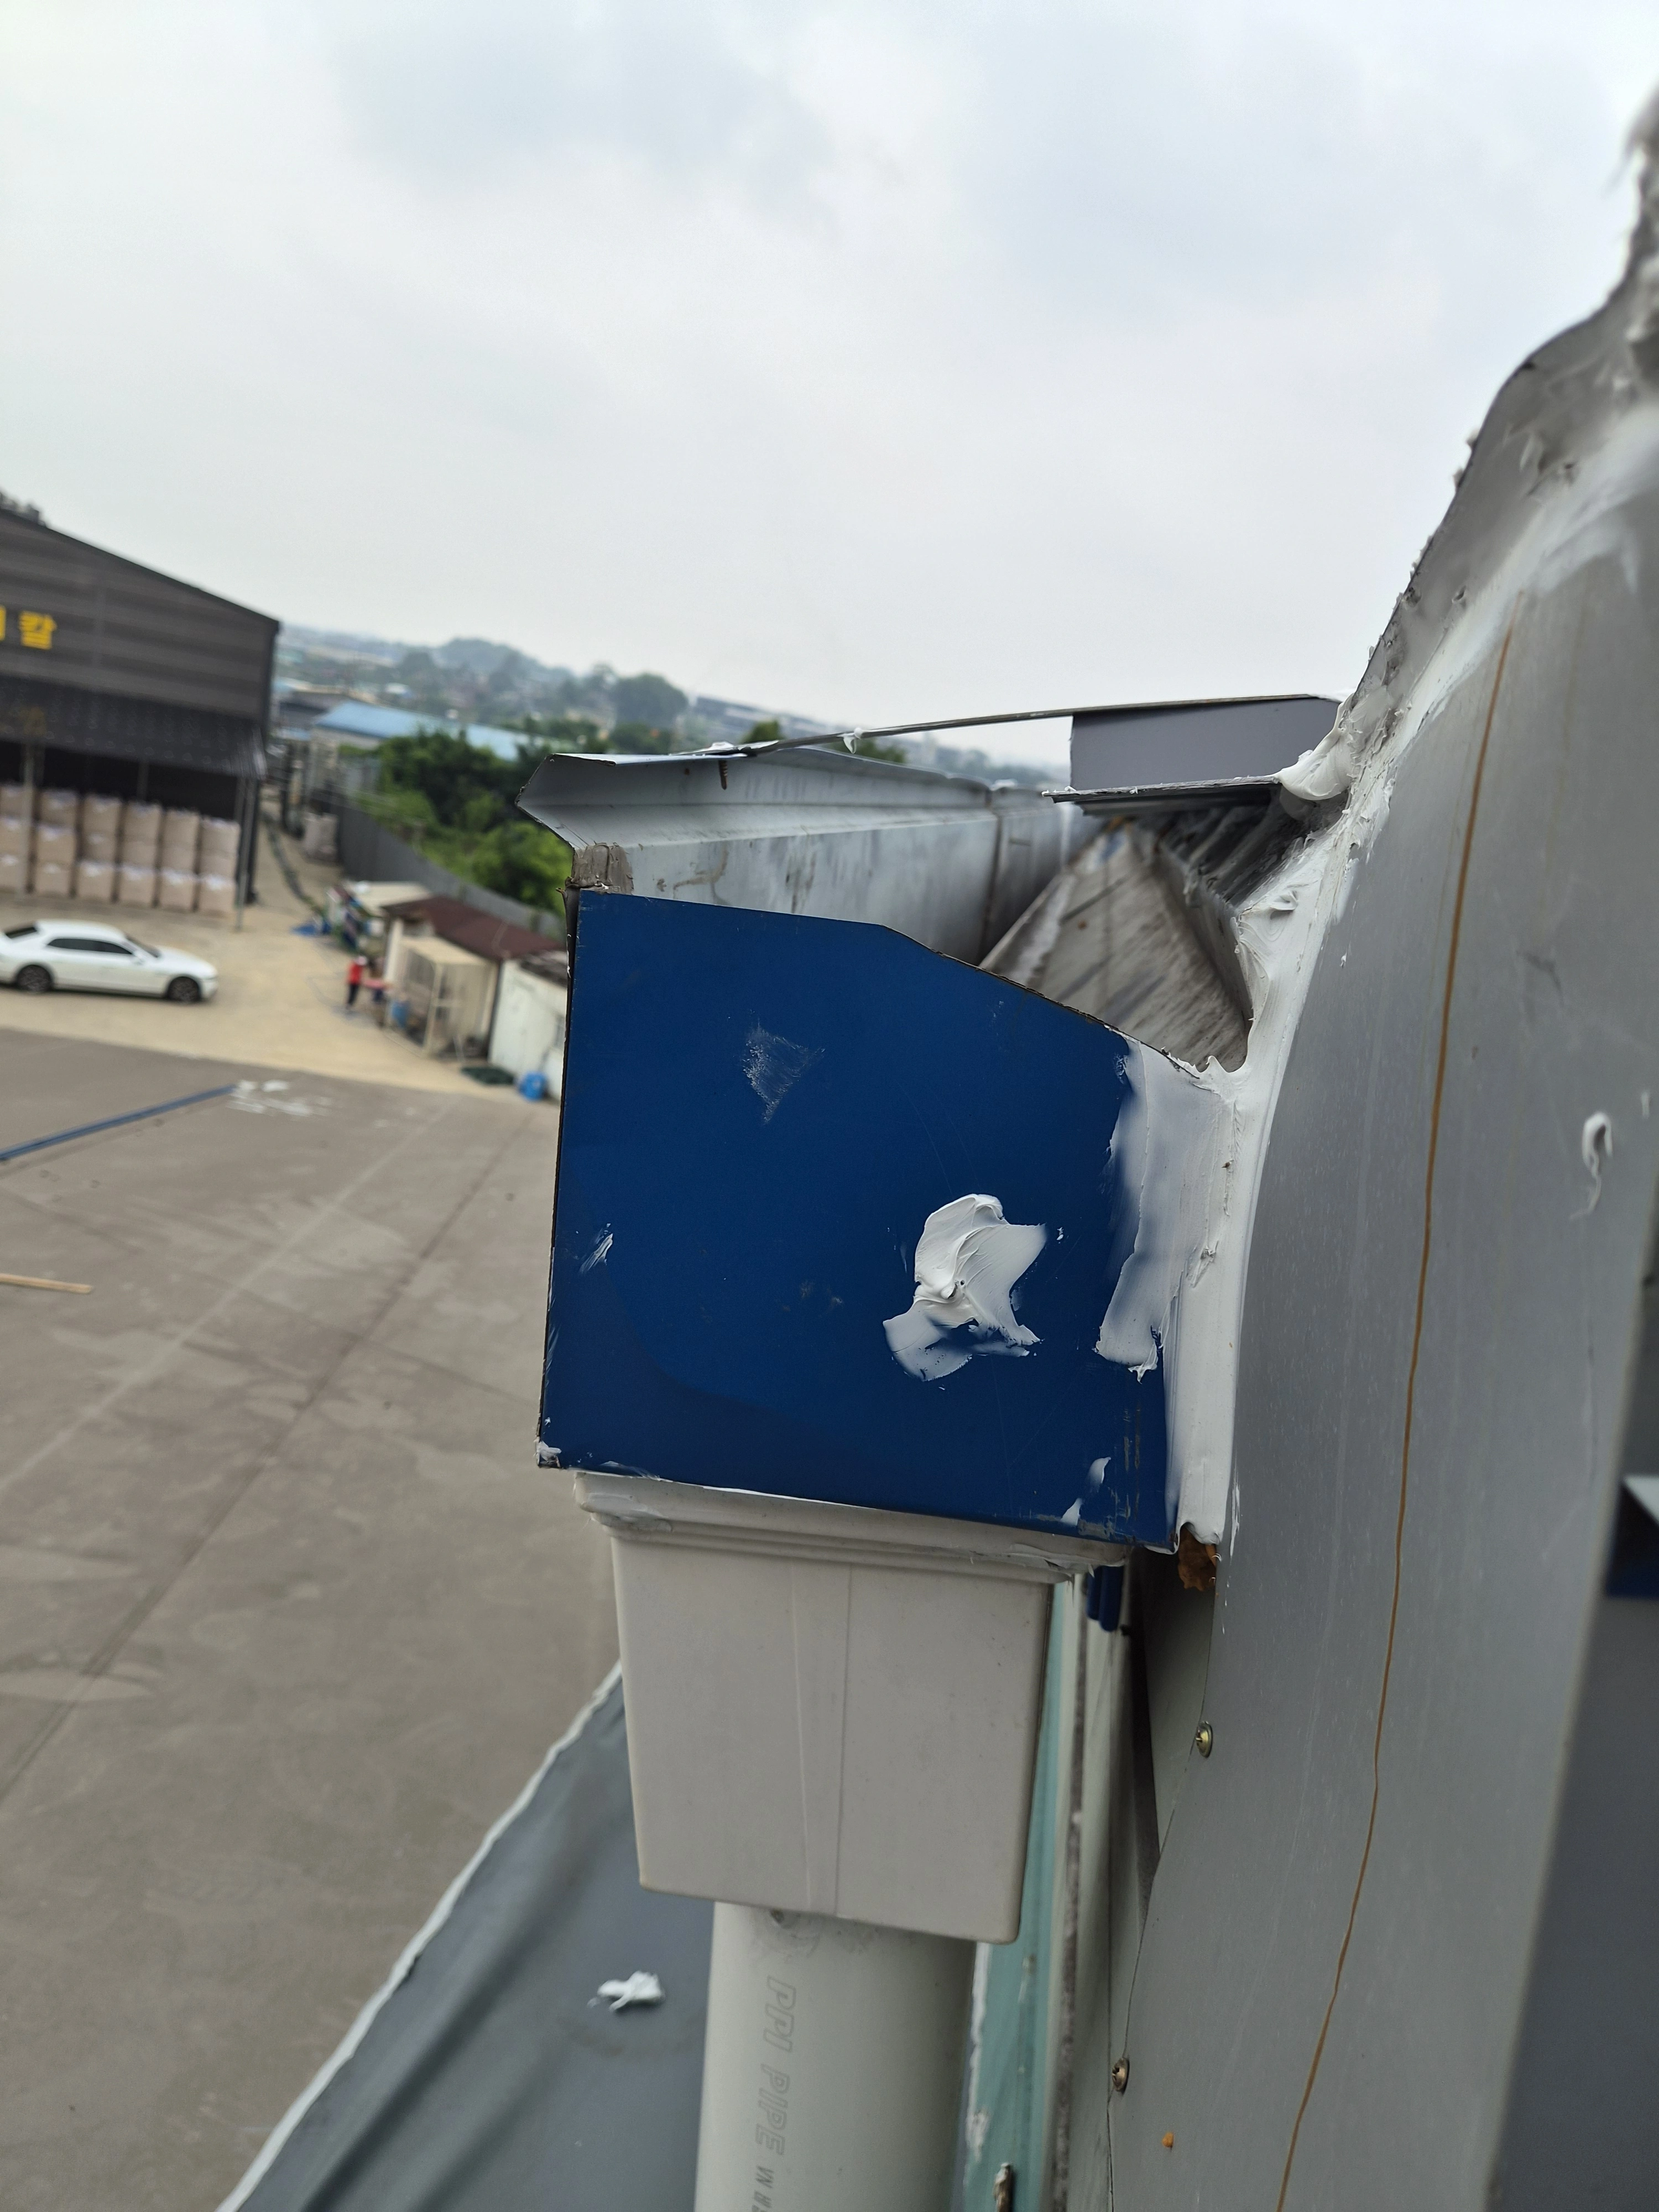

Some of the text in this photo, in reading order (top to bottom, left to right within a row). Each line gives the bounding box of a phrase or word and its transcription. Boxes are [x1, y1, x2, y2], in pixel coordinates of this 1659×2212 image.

[0, 604, 58, 650] 칼
[763, 1975, 796, 2053] PPI
[754, 2063, 791, 2156] PIPE
